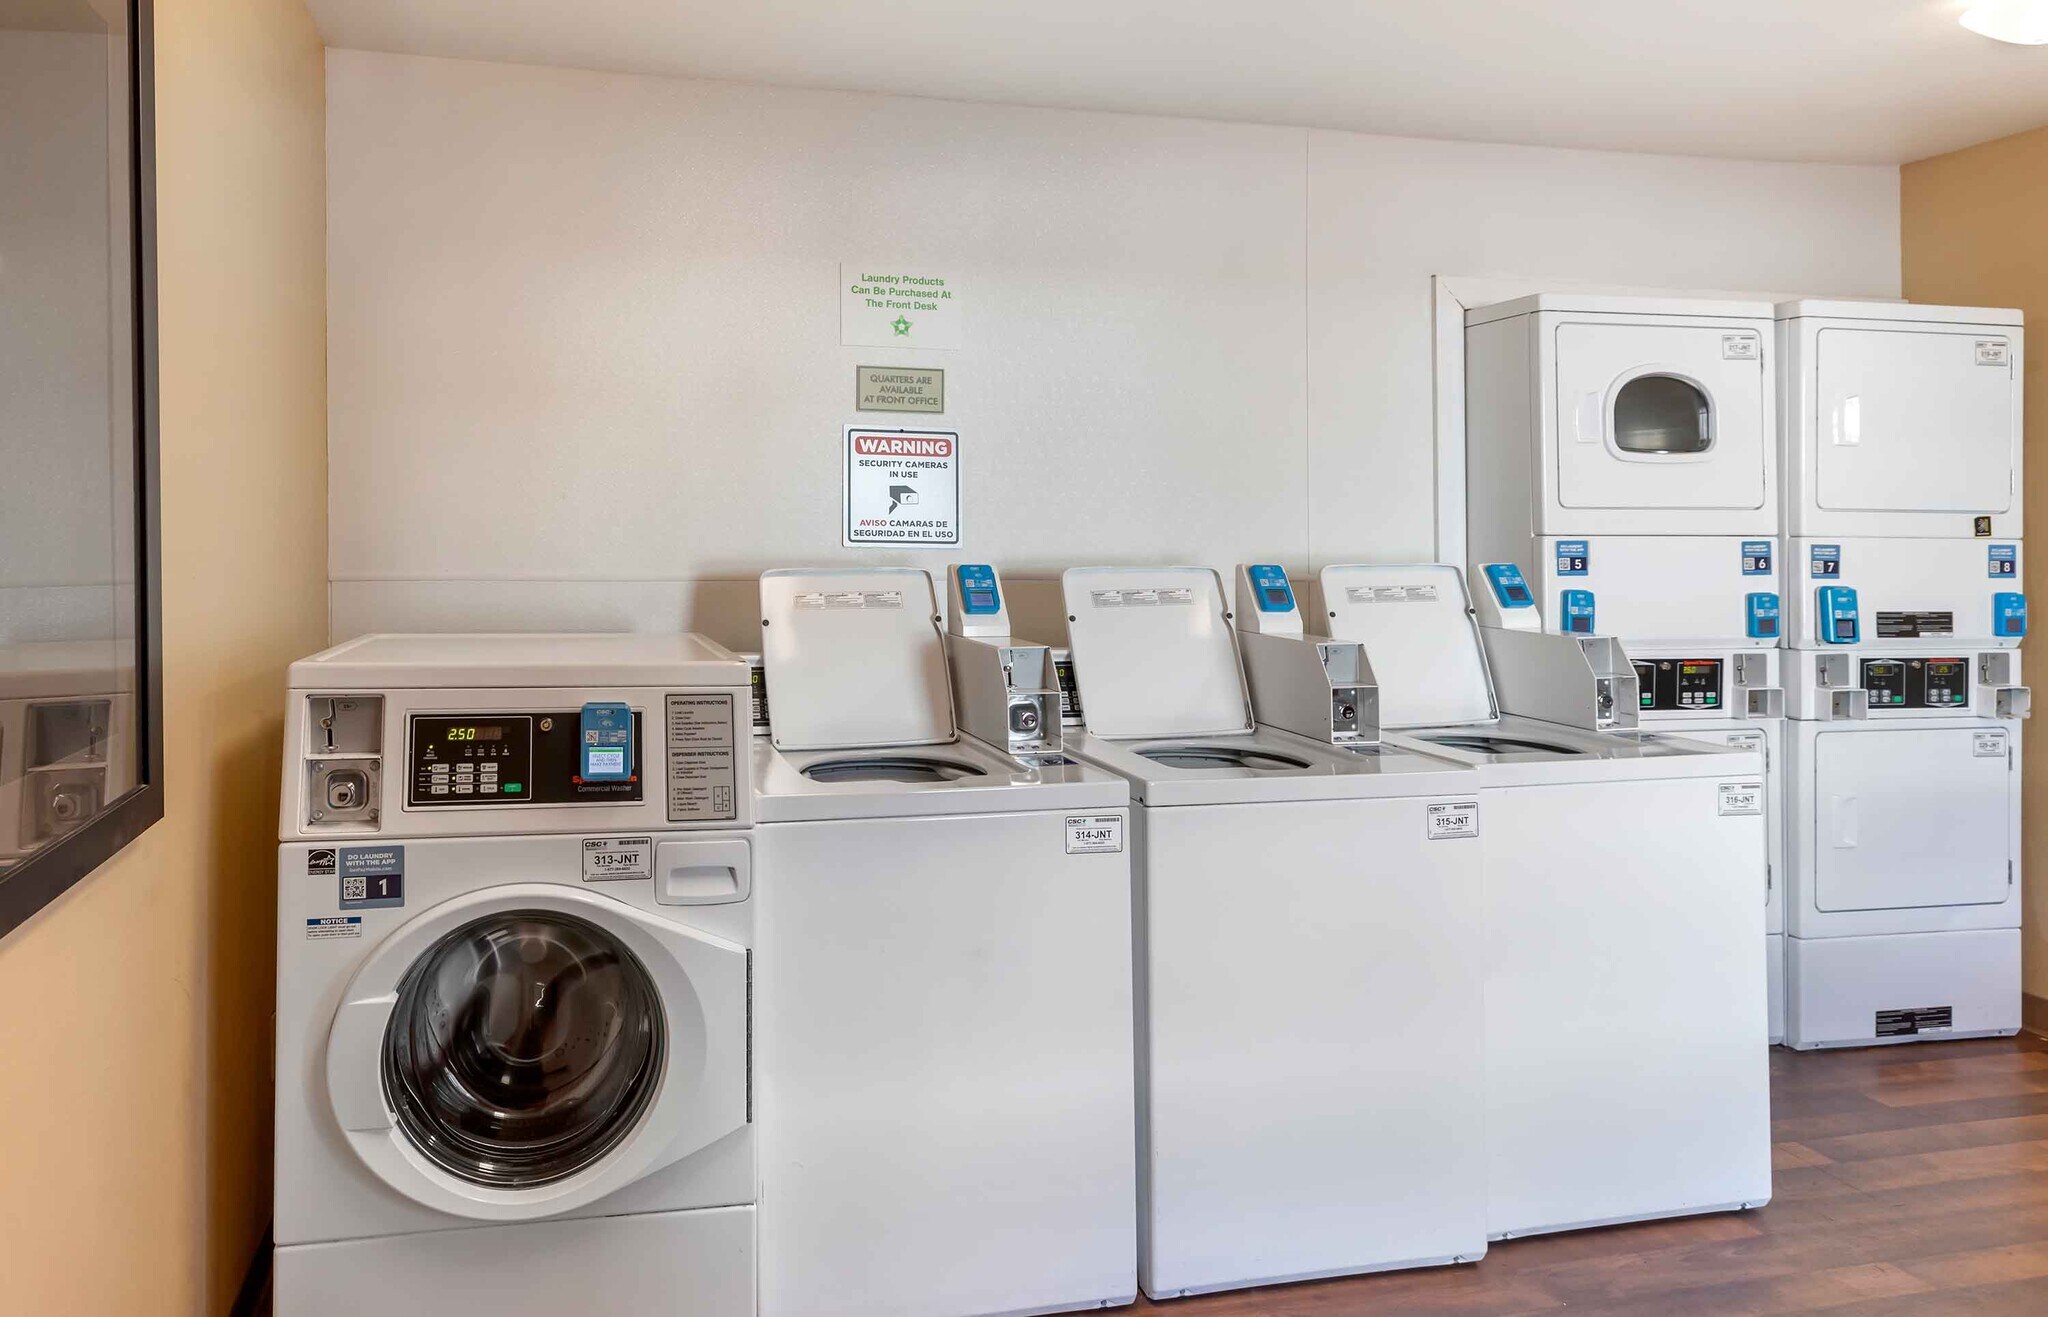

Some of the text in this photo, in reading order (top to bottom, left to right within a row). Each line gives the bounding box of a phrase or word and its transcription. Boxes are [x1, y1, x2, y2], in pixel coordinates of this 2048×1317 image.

[862, 273, 944, 286] Laundry Products
[851, 286, 952, 299] Can Be Purchased At
[866, 299, 938, 310] The Front Desk
[870, 374, 932, 384] QUARTERS ARE
[879, 386, 924, 395] AVAILABLE
[864, 395, 938, 405] AT FRONT OFFICE
[859, 438, 948, 454] WARNING
[859, 460, 948, 469] SECURITY CAMERAS
[1575, 559, 1582, 569] 5
[1759, 559, 1766, 568] 6
[1827, 563, 1834, 572] 7
[2004, 562, 2010, 572] 8
[448, 729, 475, 740] 2.50
[1436, 817, 1469, 826] 315-JNT
[1075, 830, 1112, 839] 314-JNT
[594, 854, 639, 864] 313-JNT
[379, 878, 386, 895] 1
